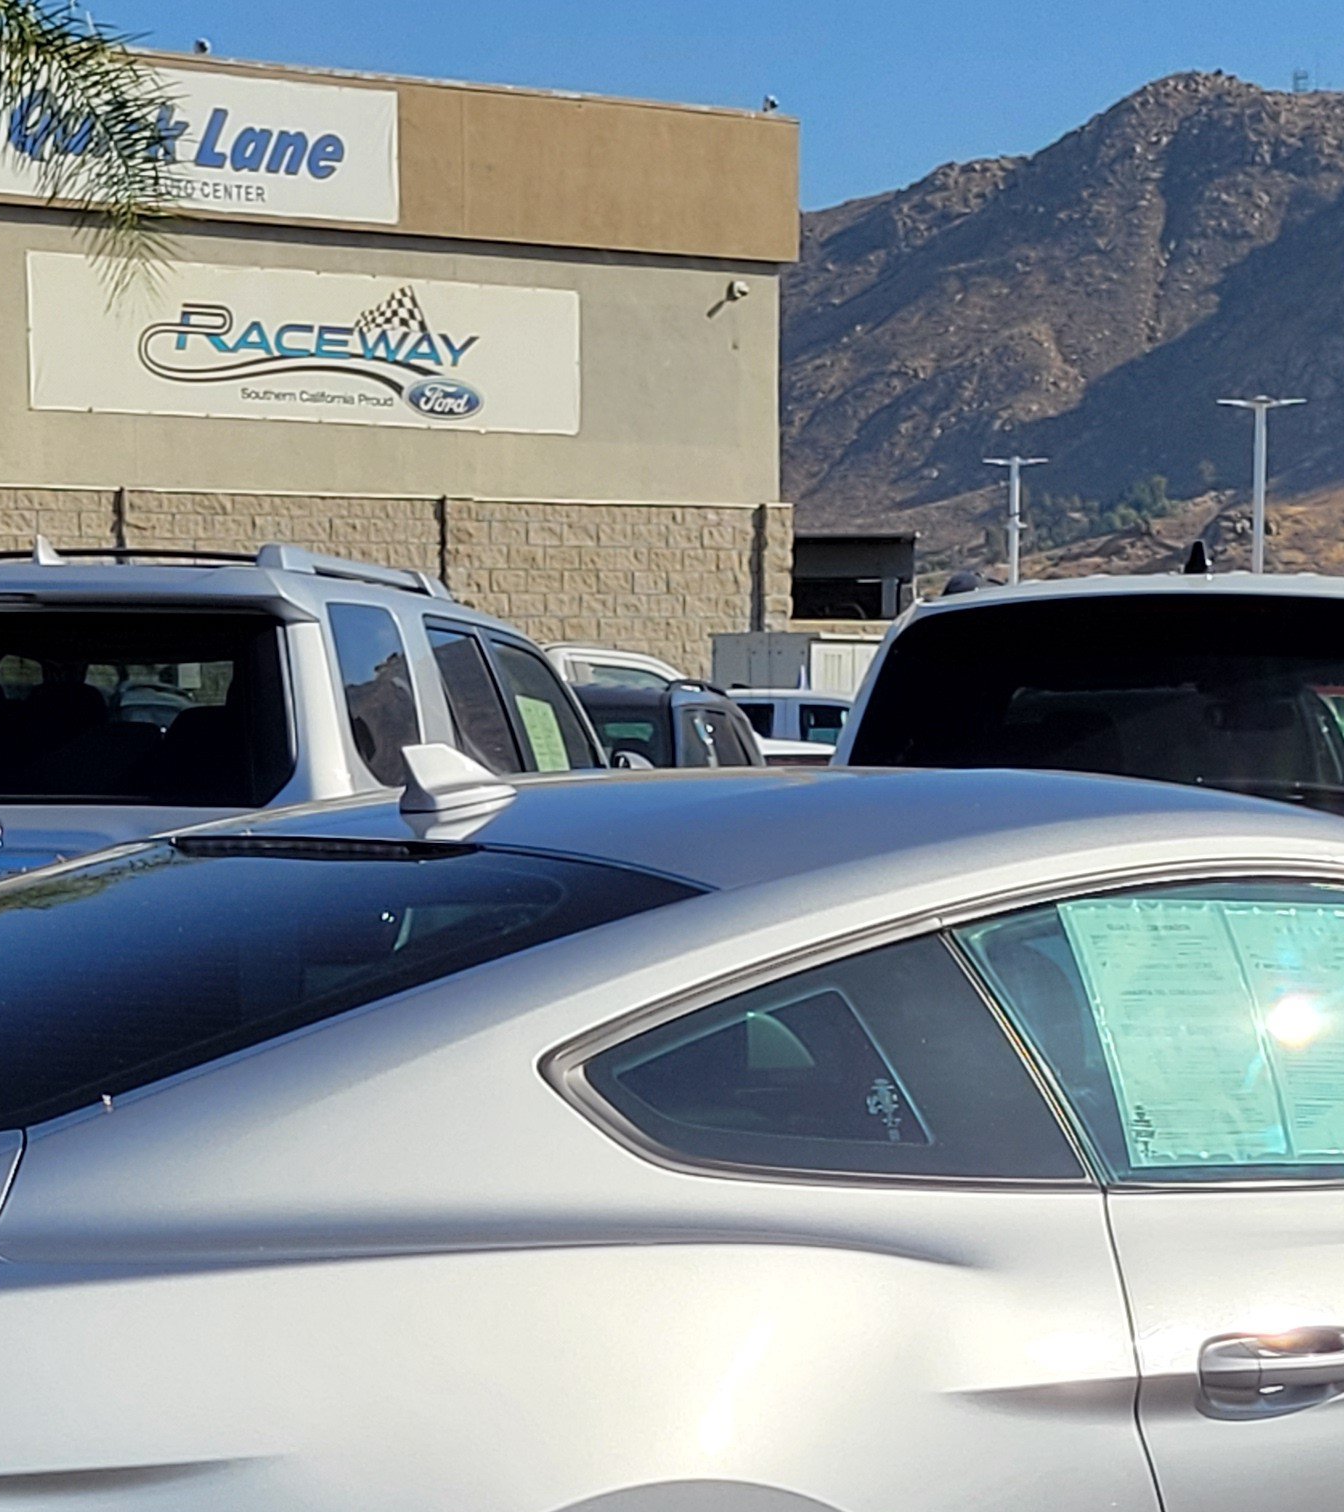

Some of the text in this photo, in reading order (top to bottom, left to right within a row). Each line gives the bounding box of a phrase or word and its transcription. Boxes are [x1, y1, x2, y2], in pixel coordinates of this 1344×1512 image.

[194, 108, 346, 180] Lane
[200, 181, 267, 203] CENTER
[175, 303, 479, 367] RACEWAY
[240, 387, 394, 407] Southern California Proud
[419, 383, 470, 414] Ford
